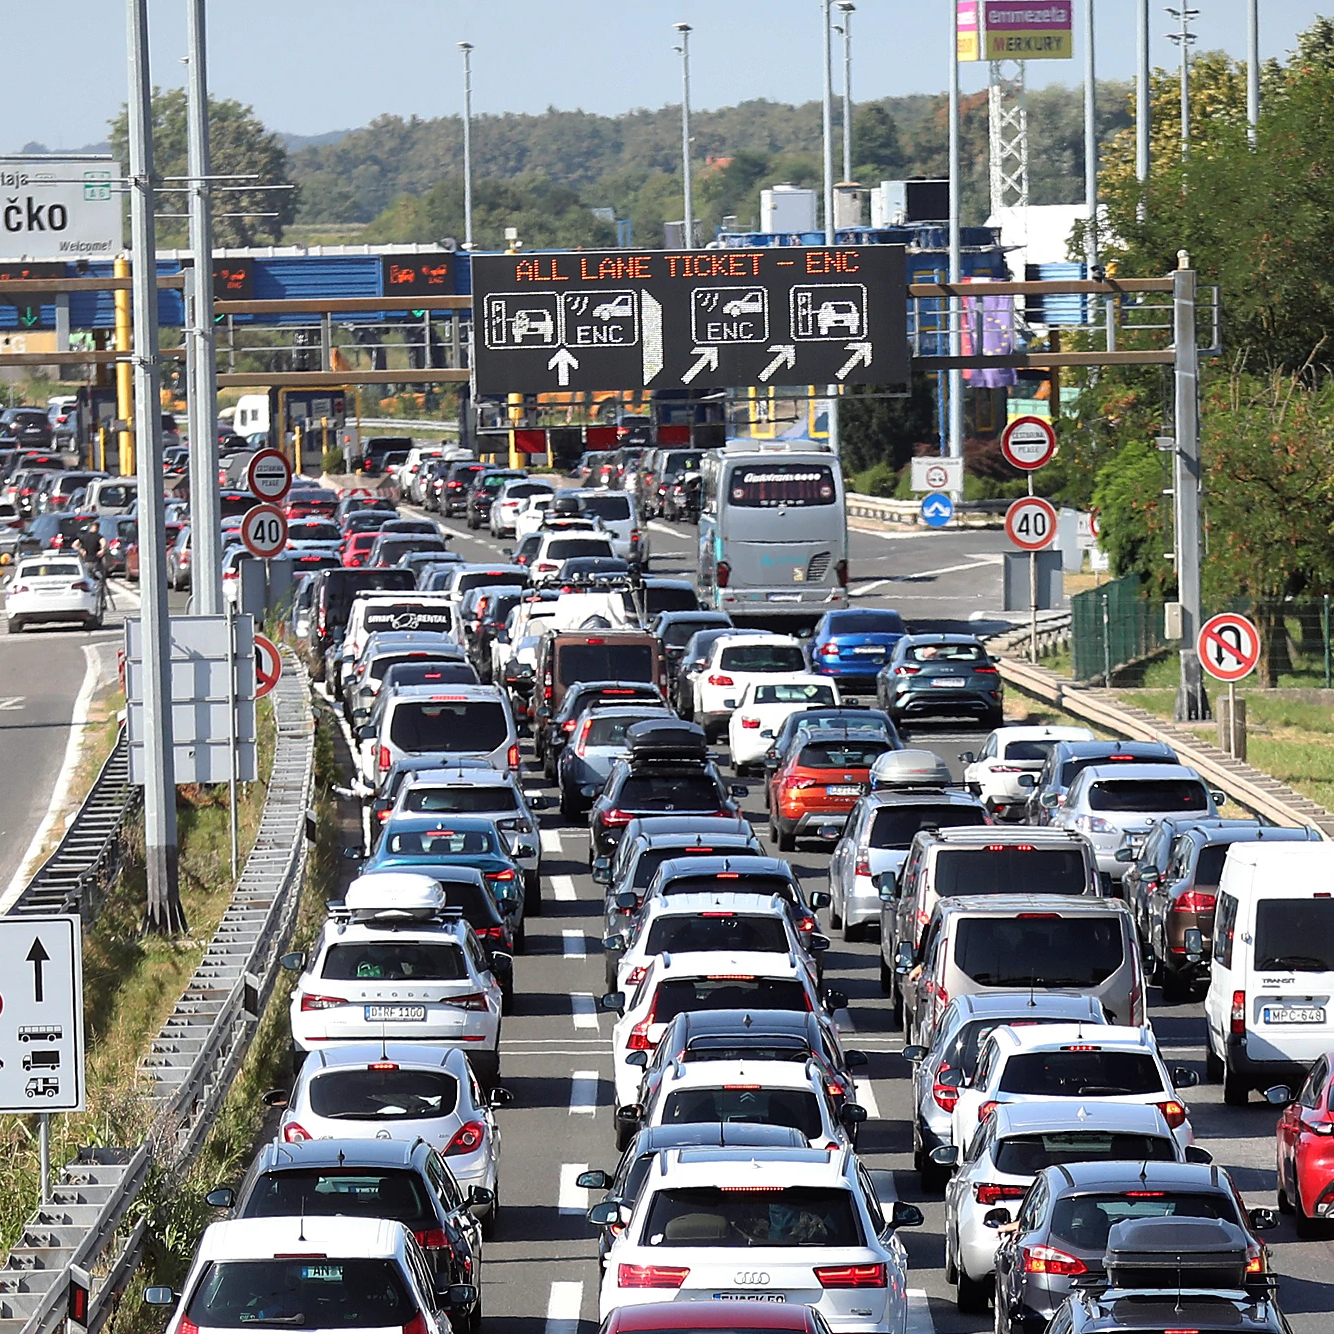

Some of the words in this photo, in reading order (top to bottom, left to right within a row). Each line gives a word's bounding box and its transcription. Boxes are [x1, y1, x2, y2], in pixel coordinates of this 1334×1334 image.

[59, 239, 113, 251] Welcome!
[516, 260, 570, 282] ALL
[581, 256, 653, 279] LANE
[665, 253, 764, 278] TICKET
[806, 251, 860, 274] ENC
[576, 324, 624, 345] ENC
[706, 321, 754, 342] ENC
[252, 518, 280, 544] 40
[1018, 512, 1046, 537] 40
[1272, 1010, 1322, 1021] MPC-648
